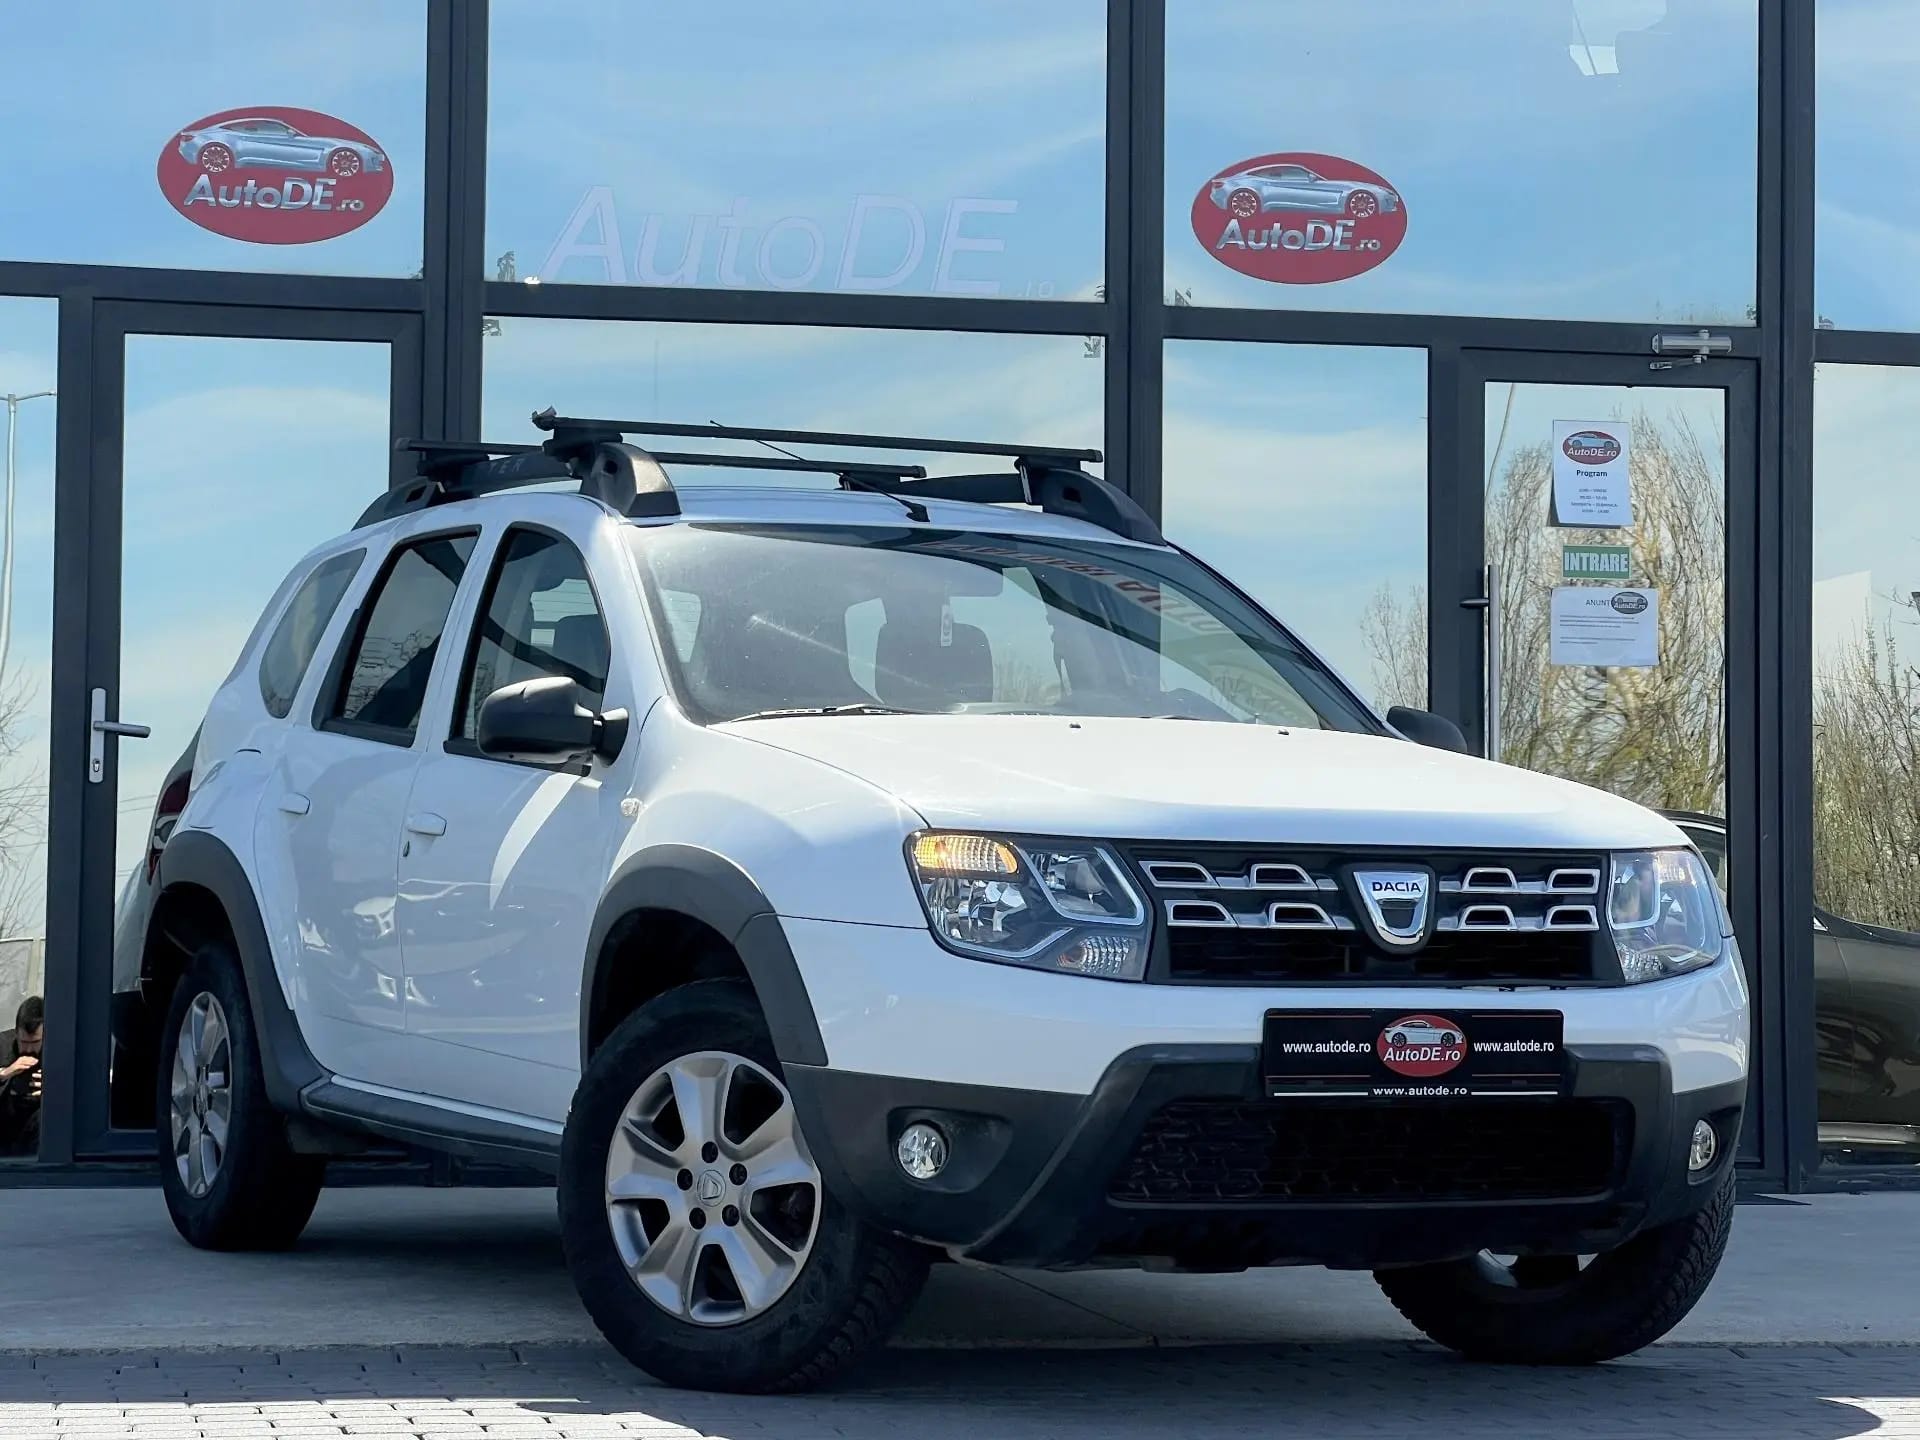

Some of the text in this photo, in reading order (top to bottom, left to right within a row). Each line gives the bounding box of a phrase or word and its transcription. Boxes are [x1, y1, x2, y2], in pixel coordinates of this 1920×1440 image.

[1567, 446, 1617, 458] AutoDE.ro
[1576, 469, 1608, 478] Program
[1564, 552, 1629, 572] INTRARE
[1372, 882, 1422, 892] DACIA
[1283, 1041, 1371, 1053] www.autode.ro
[1473, 1040, 1554, 1052] www.autode.ro
[1383, 1047, 1461, 1062] AutoDE.ro
[1373, 1086, 1467, 1096] www.autode.ro
